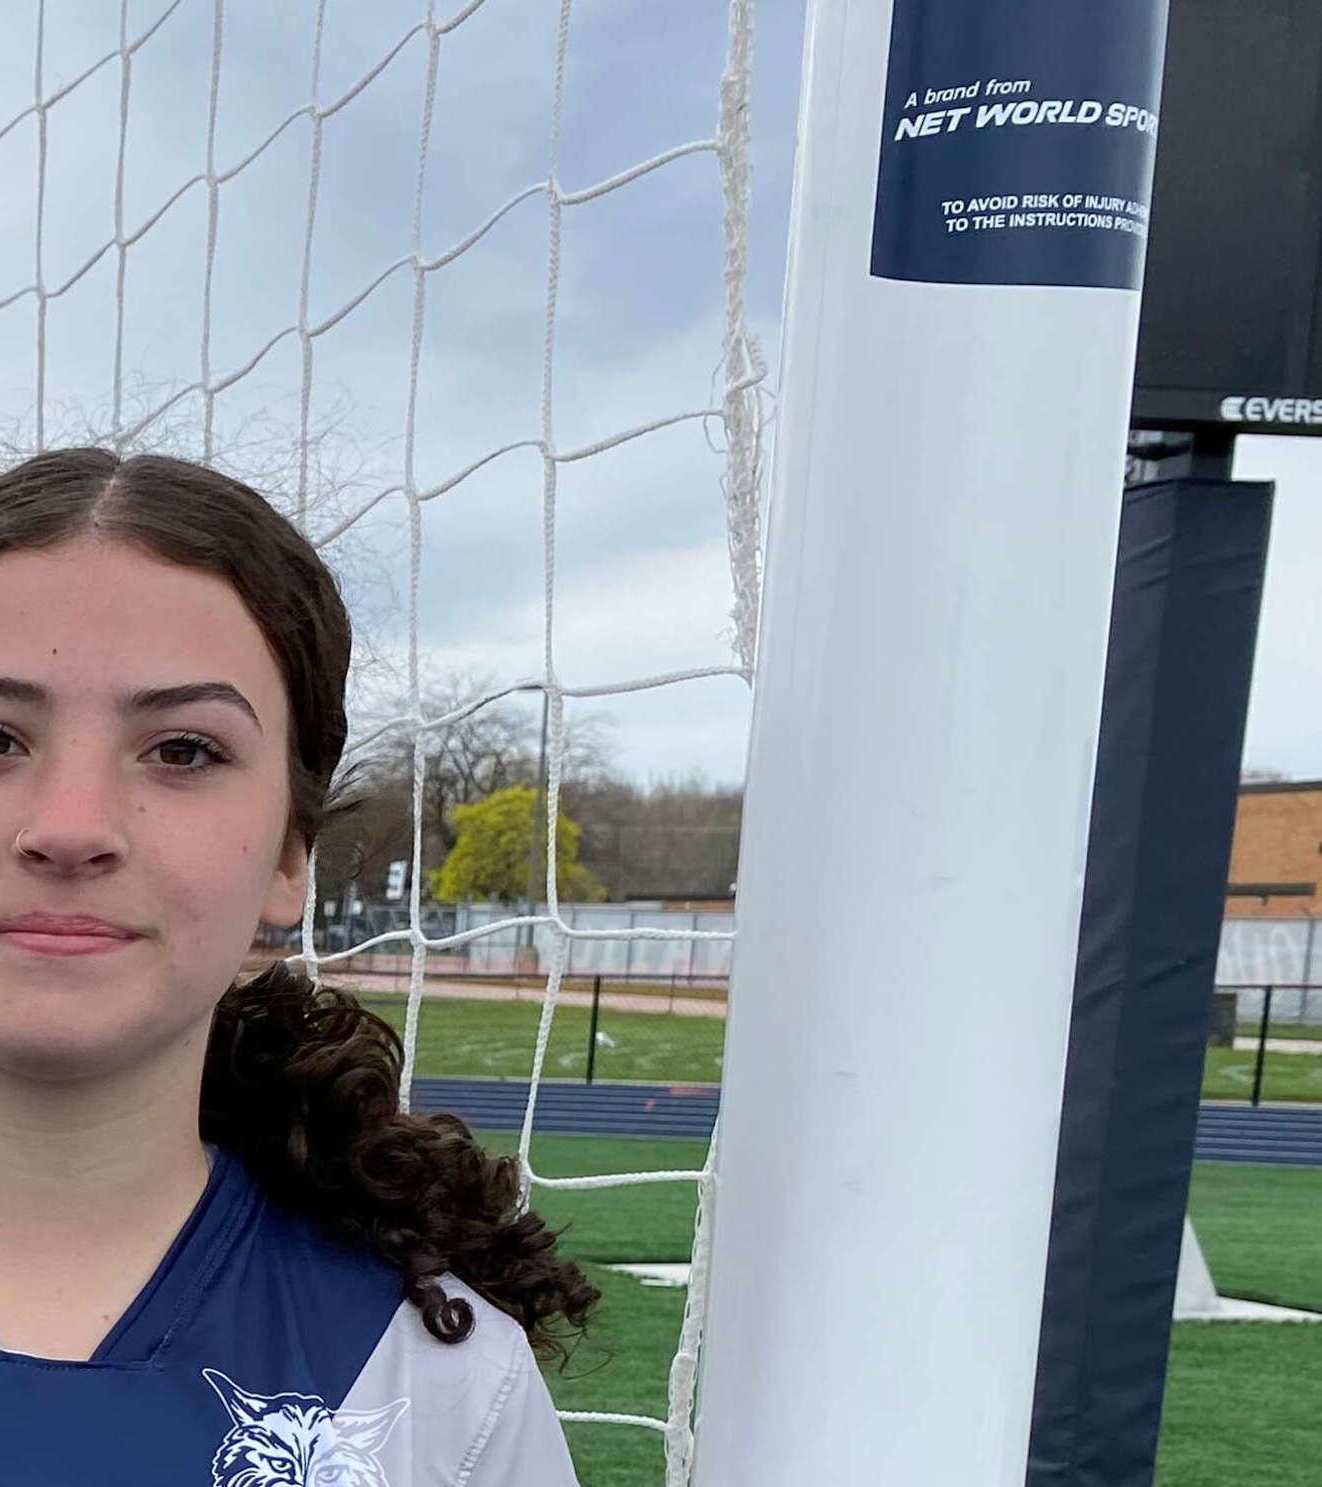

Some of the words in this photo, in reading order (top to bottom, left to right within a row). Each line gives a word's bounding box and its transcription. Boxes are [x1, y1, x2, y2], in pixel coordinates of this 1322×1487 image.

[904, 92, 918, 108] A
[924, 80, 981, 104] brand
[985, 79, 1032, 96] from
[894, 107, 972, 141] NET
[975, 100, 1103, 128] WORLD
[942, 200, 964, 215] TO
[967, 196, 1018, 212] AVOID
[1022, 194, 1059, 208] RISK
[1062, 194, 1083, 208] OF
[1085, 195, 1126, 212] INJURY
[946, 218, 968, 233] TO
[973, 215, 1005, 230] THE
[1009, 212, 1113, 229] INSTRUCTIONS
